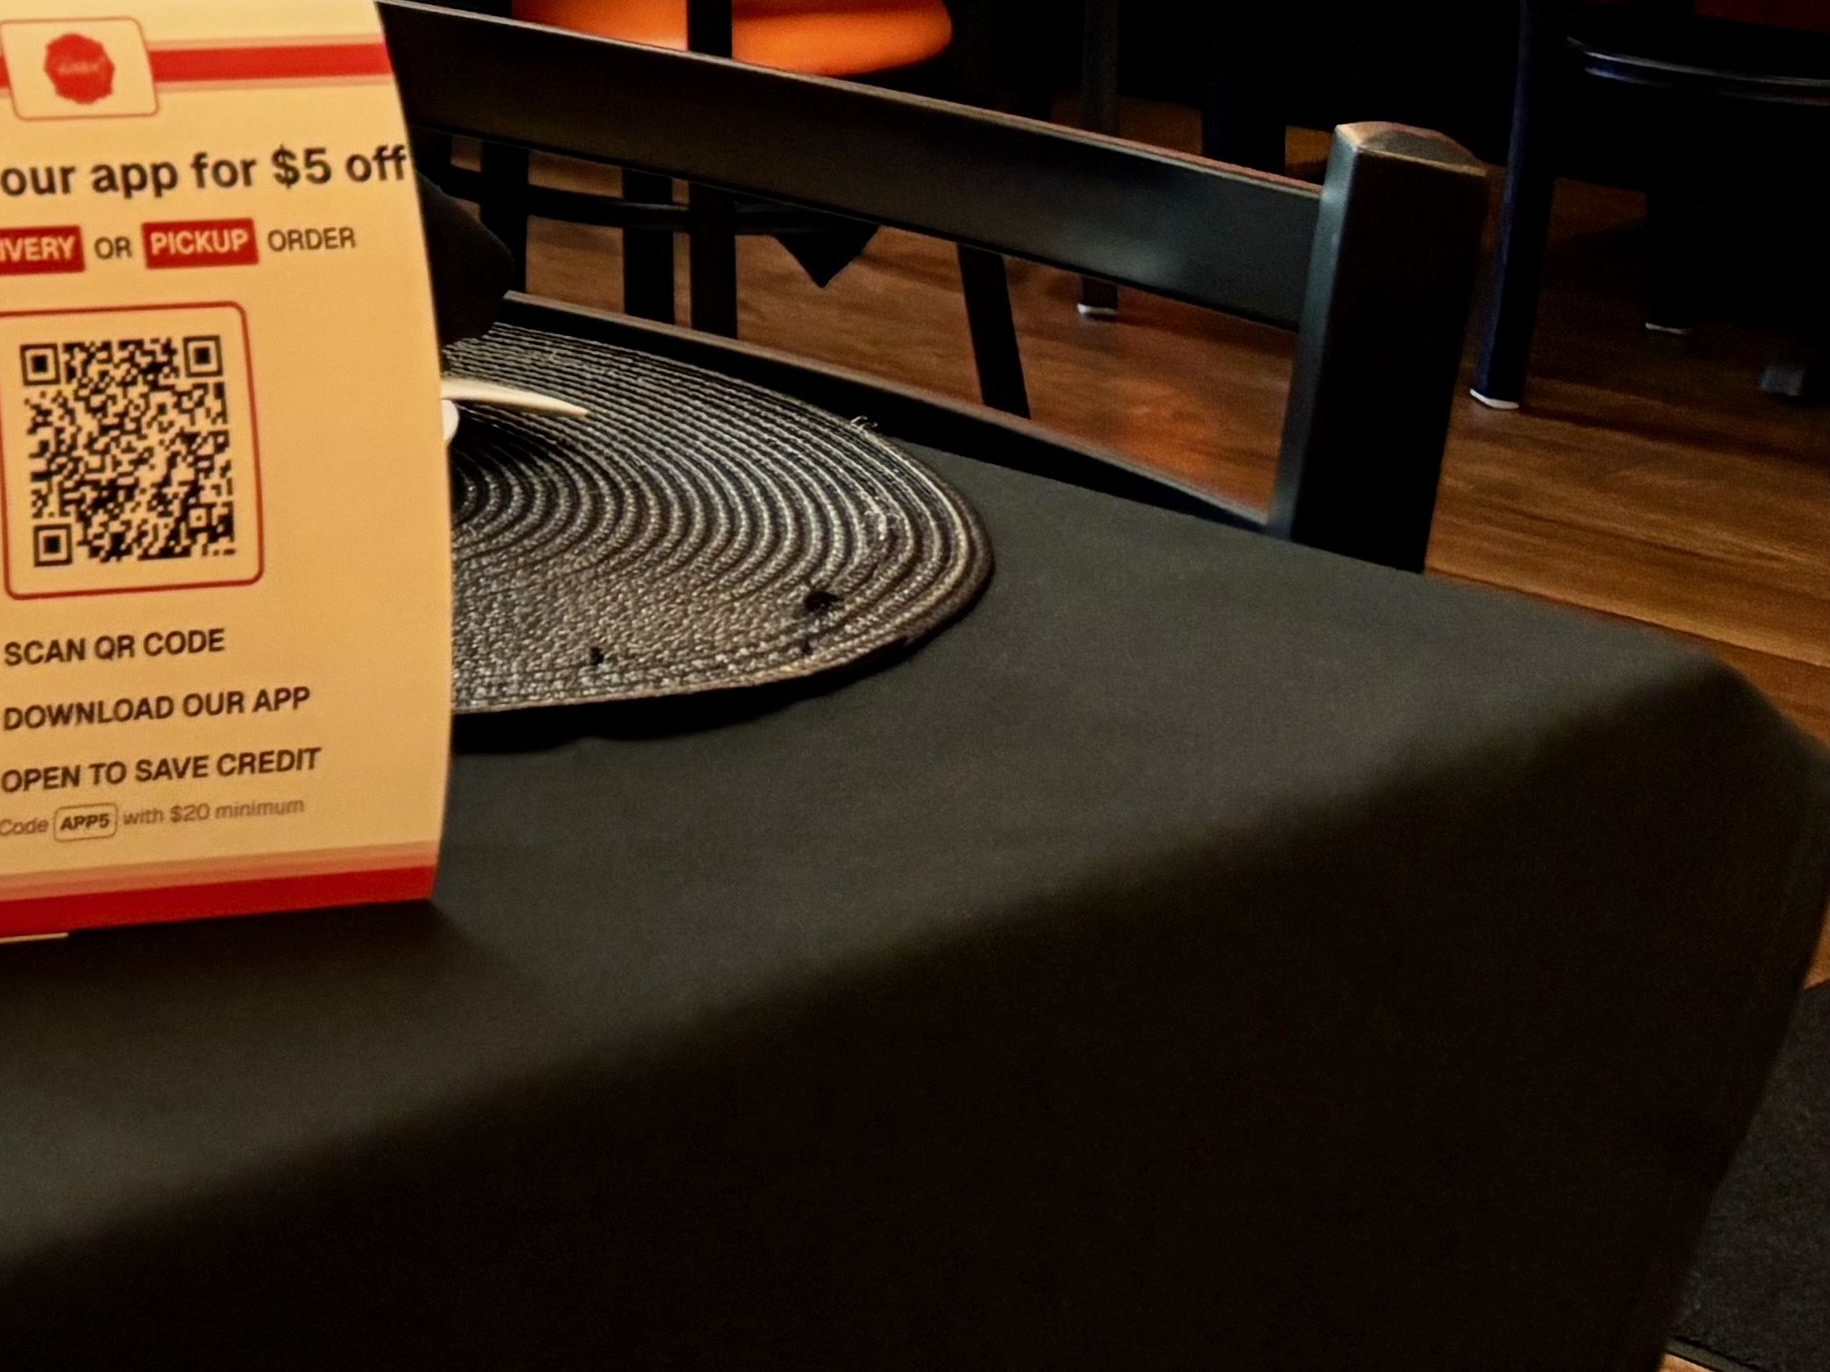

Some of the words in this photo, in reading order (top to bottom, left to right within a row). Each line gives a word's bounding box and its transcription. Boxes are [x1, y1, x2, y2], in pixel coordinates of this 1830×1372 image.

[0, 166, 76, 197] our
[91, 161, 179, 200] app
[190, 151, 257, 189] for
[271, 144, 332, 189] $5
[345, 144, 407, 183] off
[94, 236, 133, 260] OR
[150, 228, 249, 255] PICKUP
[267, 226, 356, 253] ORDER
[4, 637, 86, 667] SCAN
[94, 634, 135, 661] QR
[143, 627, 225, 657] CODE
[3, 695, 175, 731] DOWNLOAD
[182, 690, 245, 718] OUR
[252, 686, 311, 713] APP
[0, 764, 81, 794] OPEN
[88, 760, 127, 786] TO
[135, 754, 209, 783] SAVE
[216, 746, 322, 777] CREDIT
[59, 812, 111, 832] APP5
[122, 807, 165, 826] with
[169, 802, 211, 824] $20
[214, 799, 305, 820] minimum
